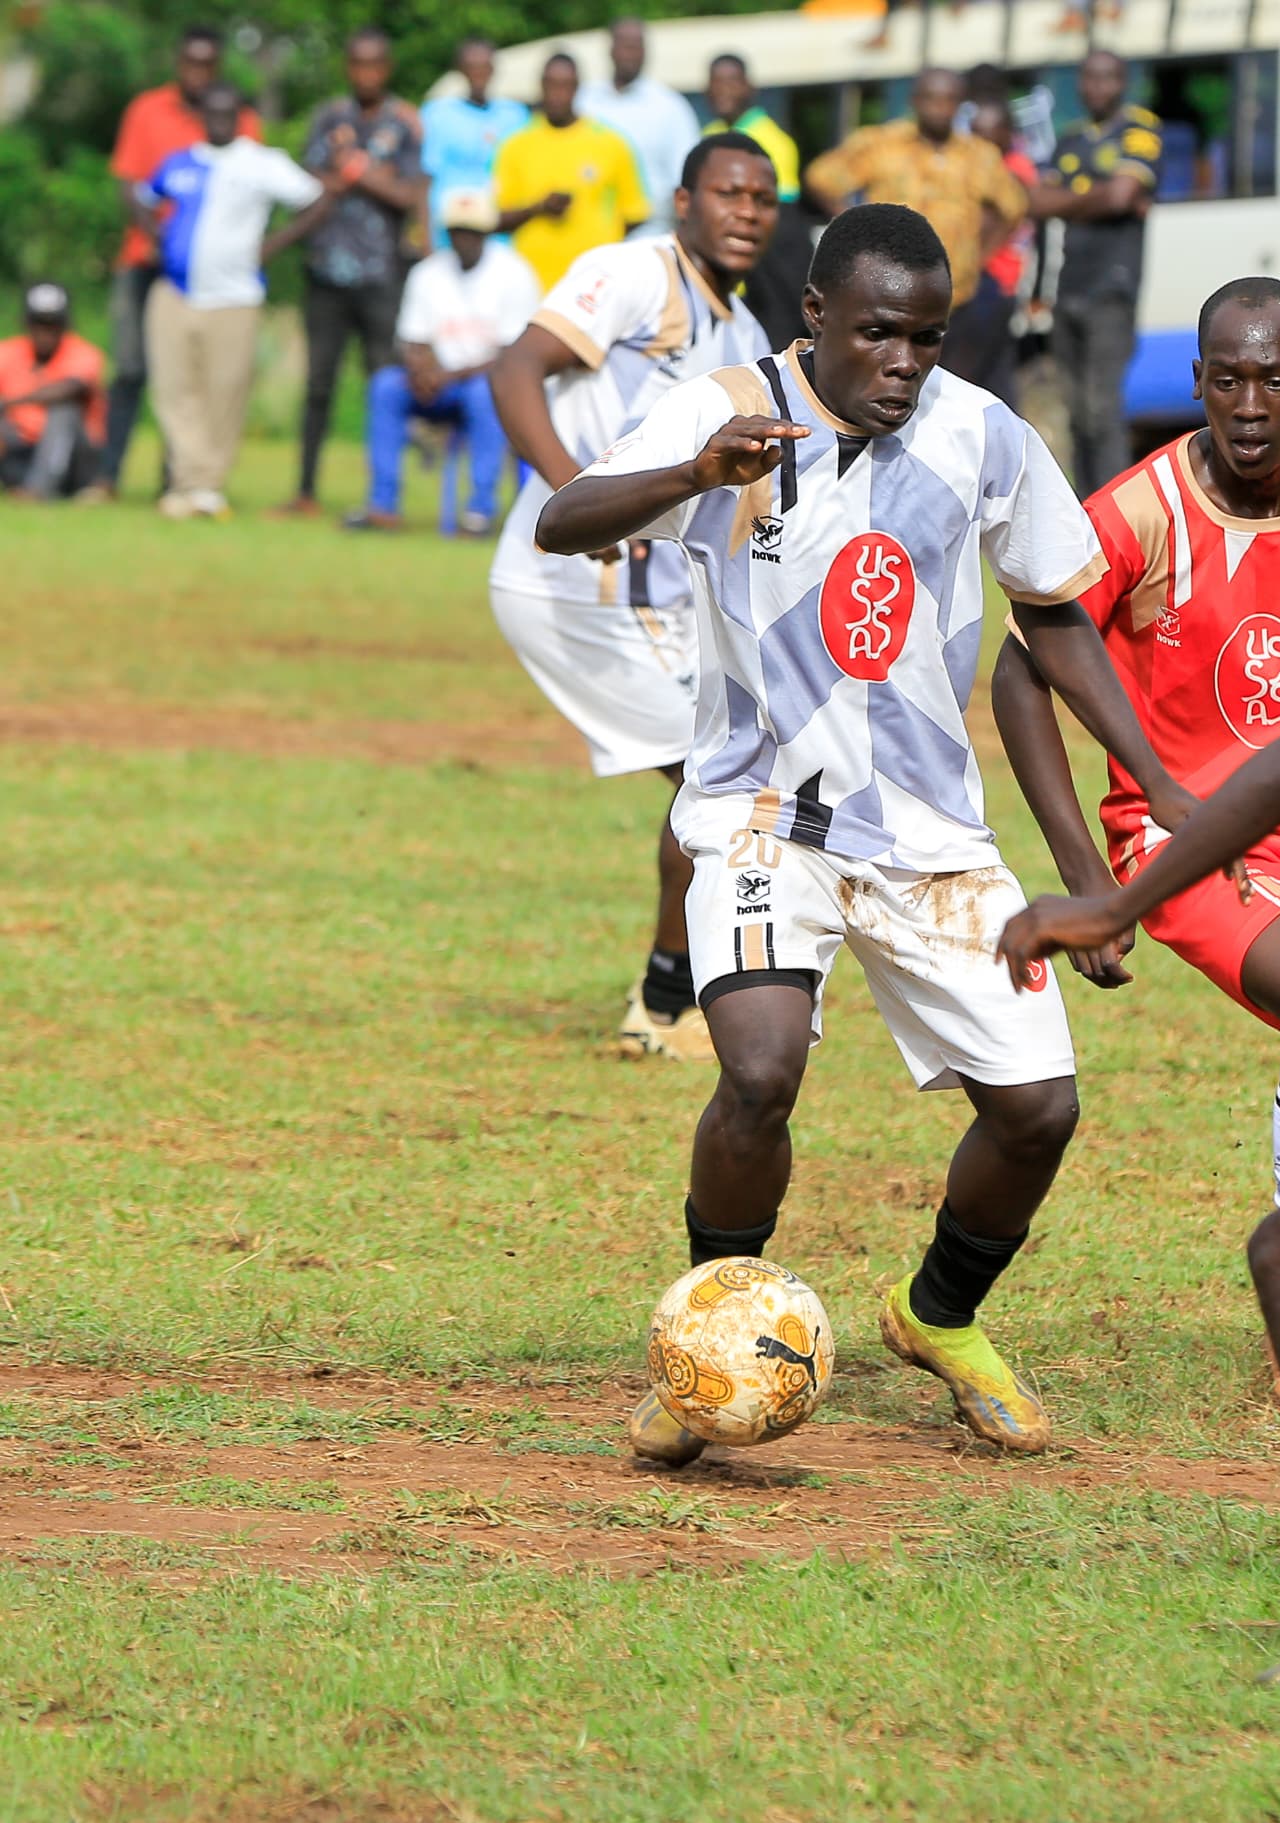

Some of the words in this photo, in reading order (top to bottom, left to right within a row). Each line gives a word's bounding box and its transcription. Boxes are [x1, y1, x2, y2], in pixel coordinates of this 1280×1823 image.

[752, 549, 782, 564] hawk
[1156, 631, 1182, 648] hawk
[727, 828, 783, 870] 20
[737, 903, 772, 916] hawk
